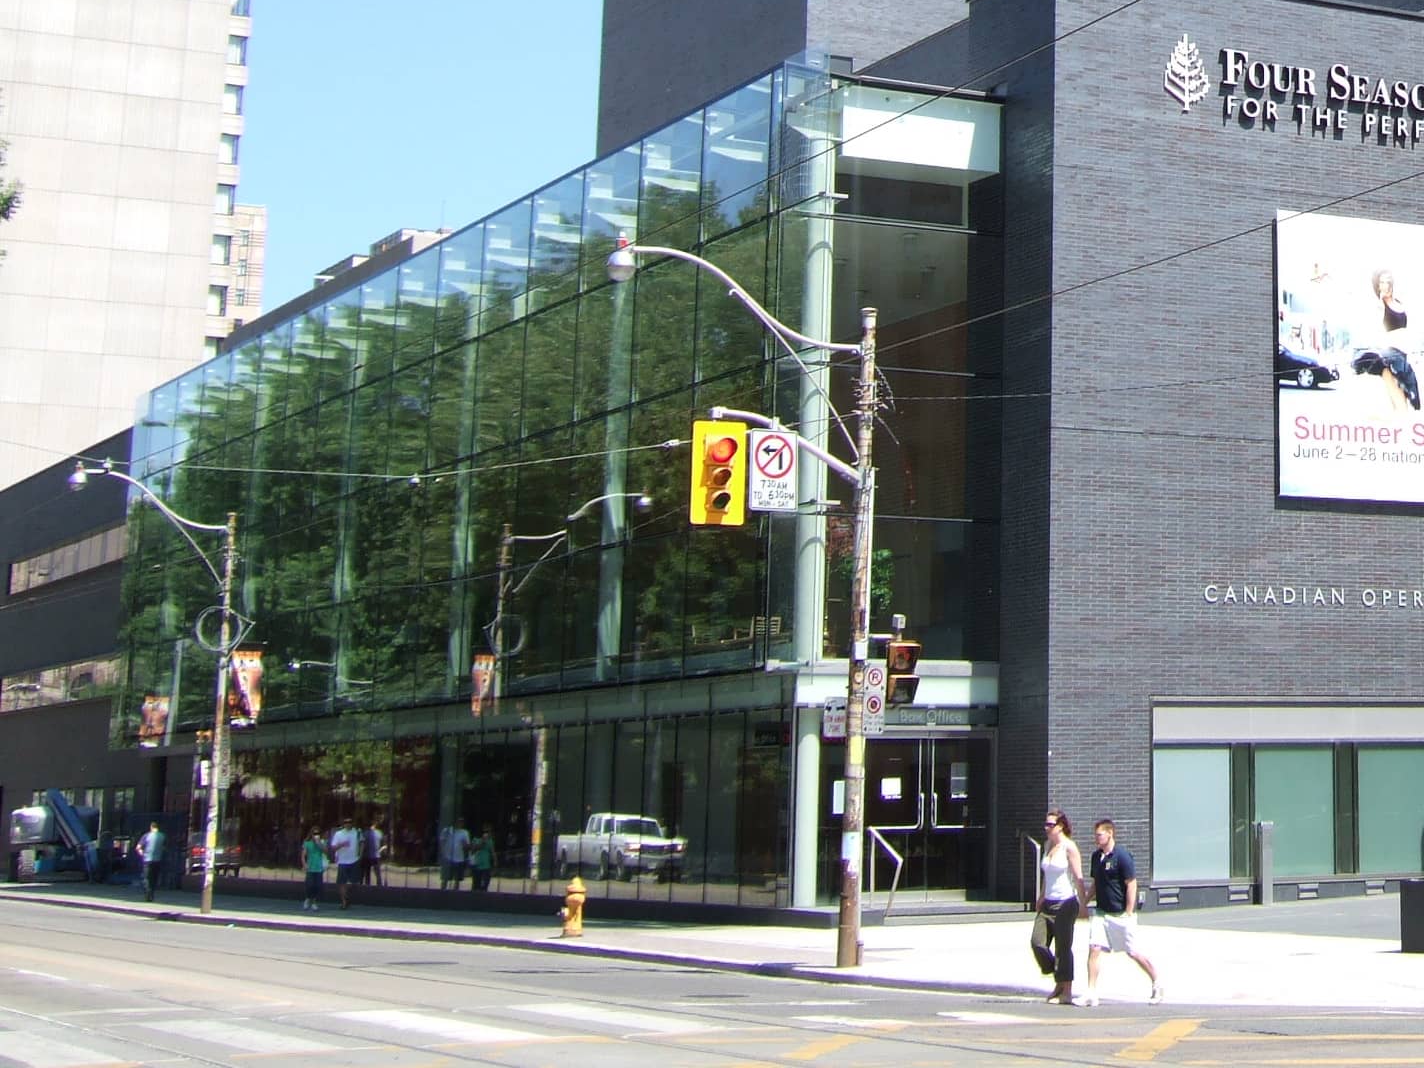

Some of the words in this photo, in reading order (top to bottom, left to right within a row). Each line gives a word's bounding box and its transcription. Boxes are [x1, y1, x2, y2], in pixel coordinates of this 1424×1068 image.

[1221, 48, 1317, 96] FOUR
[1227, 98, 1279, 121] FOR
[1297, 104, 1348, 129] THE
[1294, 416, 1402, 444] Summer
[1293, 444, 1329, 459] June
[1204, 585, 1346, 606] CANADIAN
